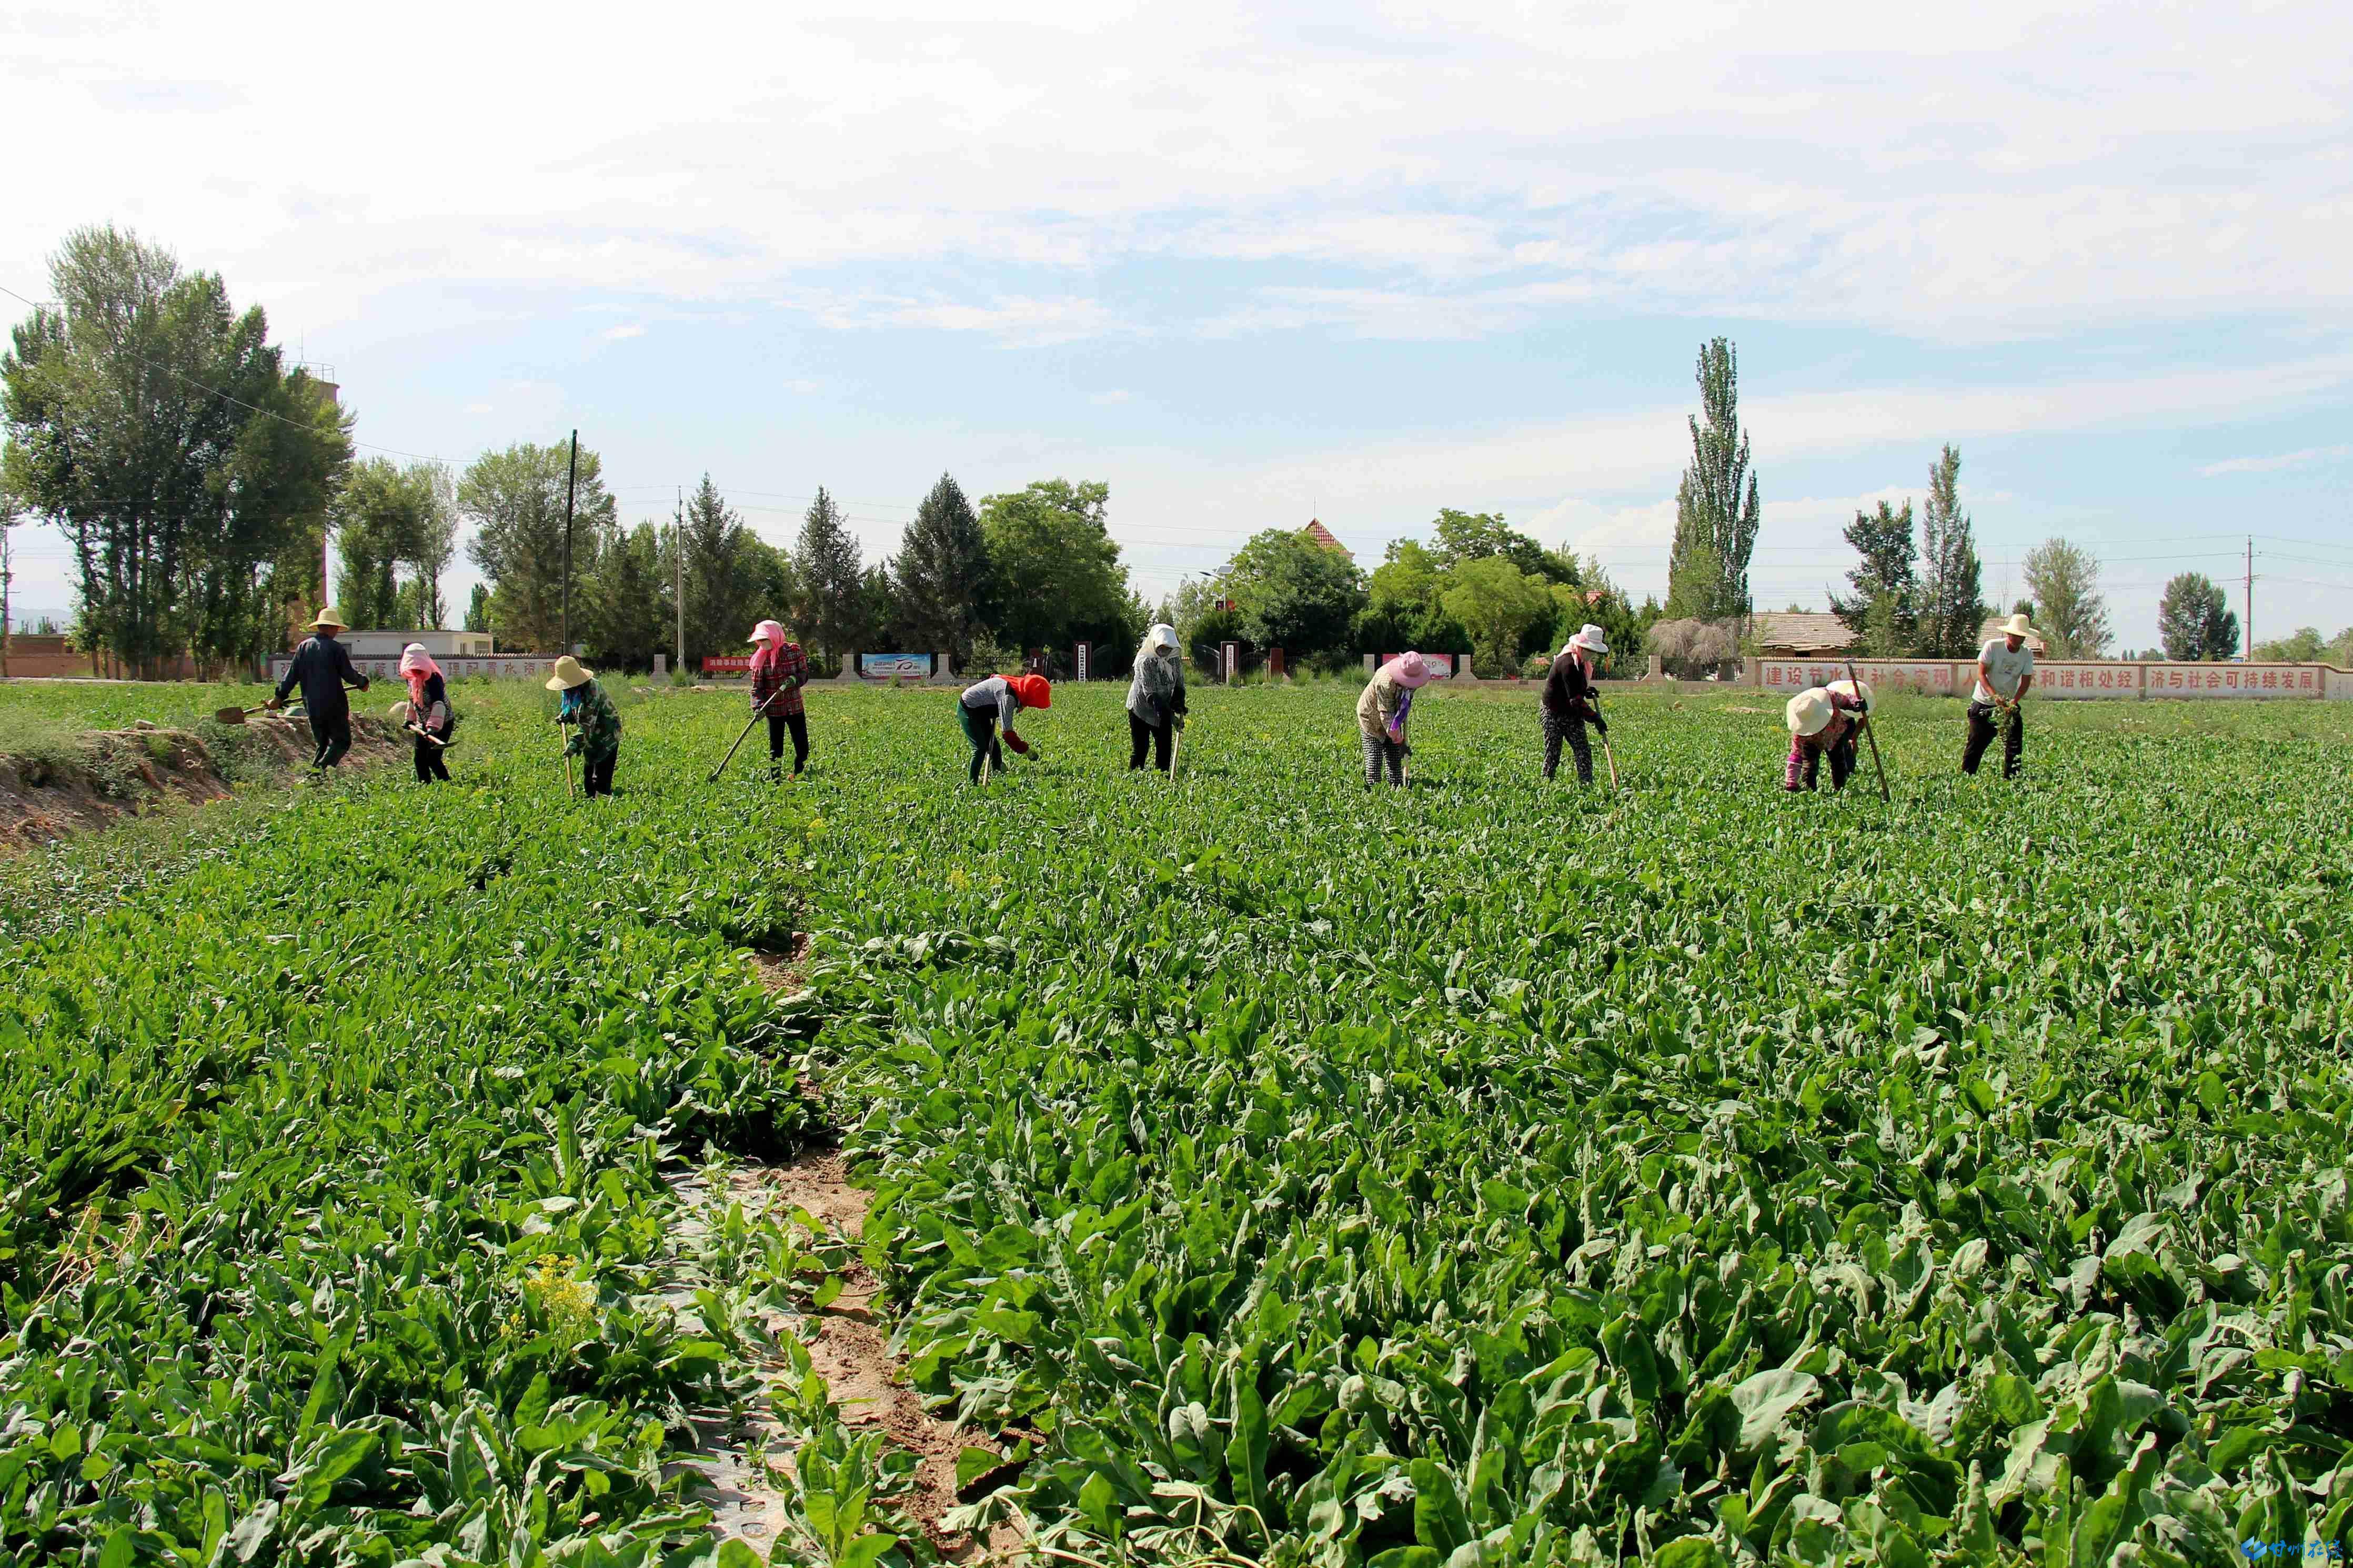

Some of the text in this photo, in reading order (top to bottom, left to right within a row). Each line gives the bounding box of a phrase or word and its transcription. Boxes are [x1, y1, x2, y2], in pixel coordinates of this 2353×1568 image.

[2151, 670, 2312, 689] 济与社会可持续发展
